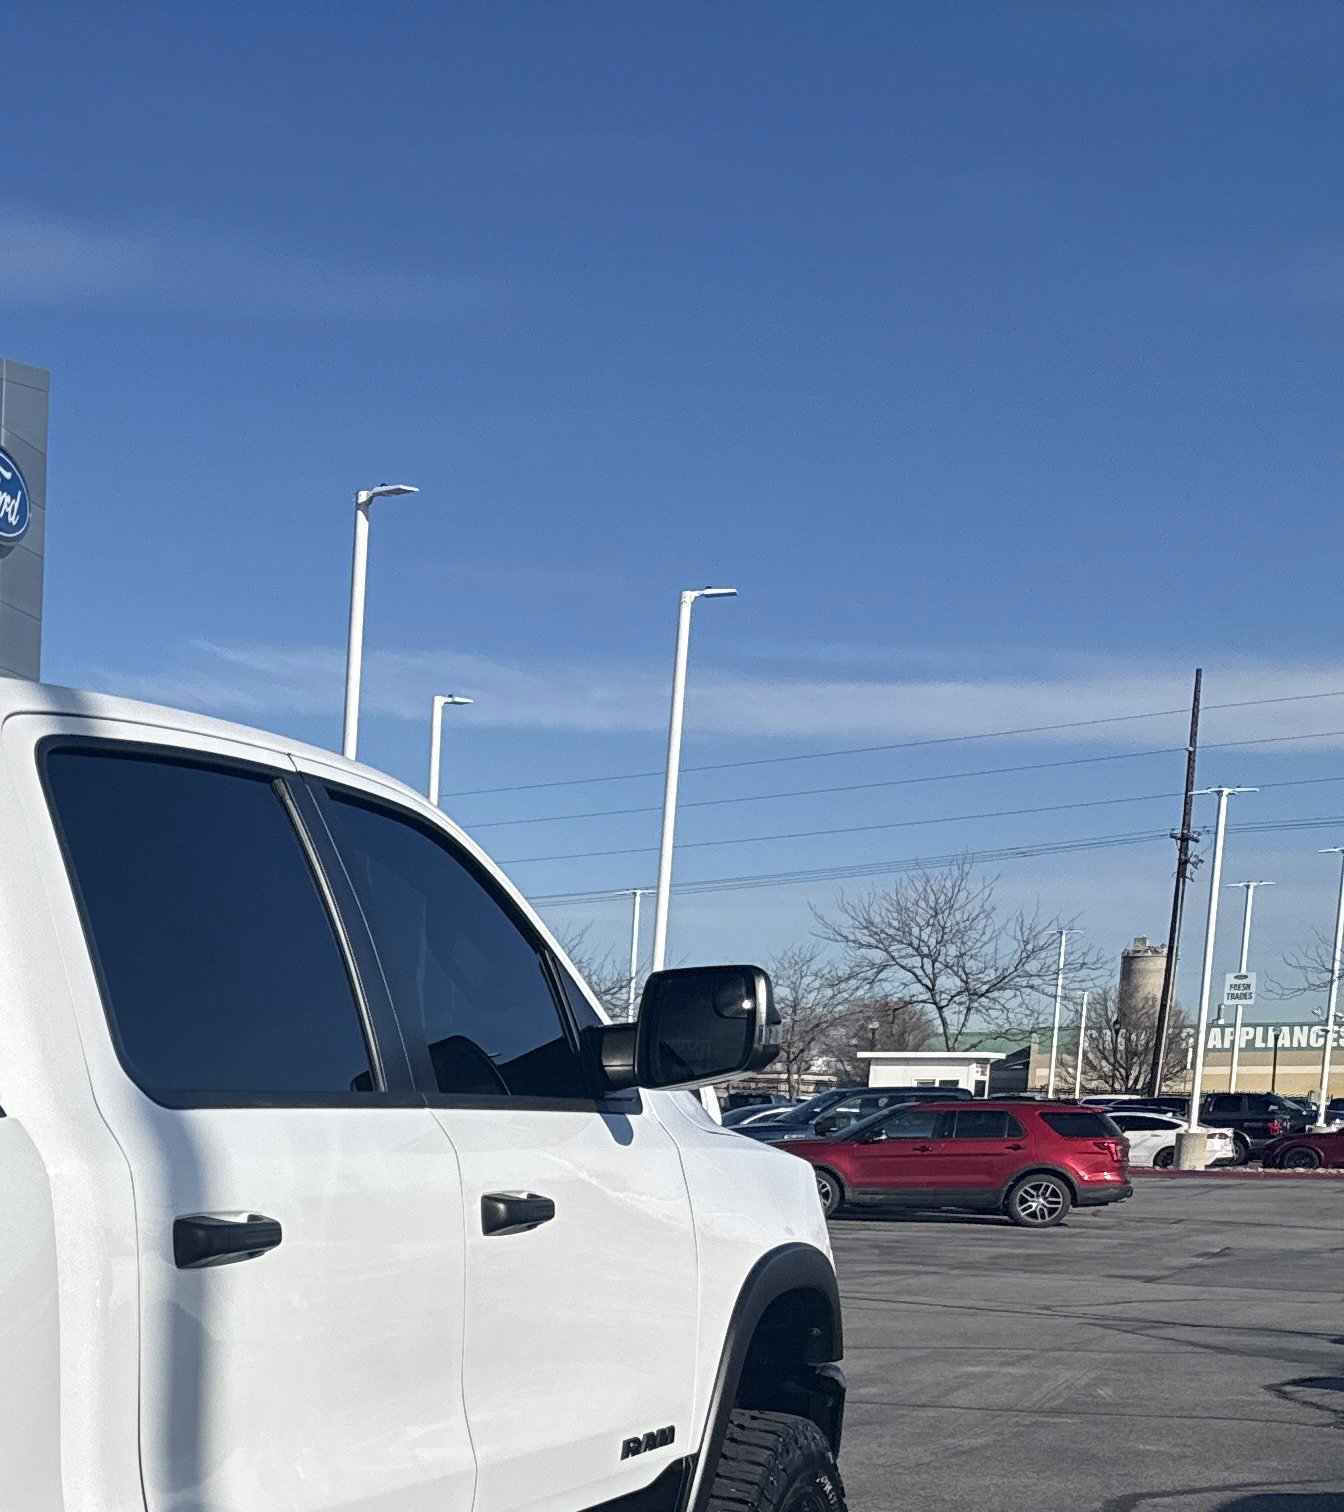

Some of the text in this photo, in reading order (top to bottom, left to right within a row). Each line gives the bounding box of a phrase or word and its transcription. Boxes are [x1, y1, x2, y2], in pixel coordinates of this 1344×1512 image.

[1229, 983, 1251, 991] FRESH
[1226, 992, 1253, 1000] TRADES
[620, 1424, 675, 1461] RAM
